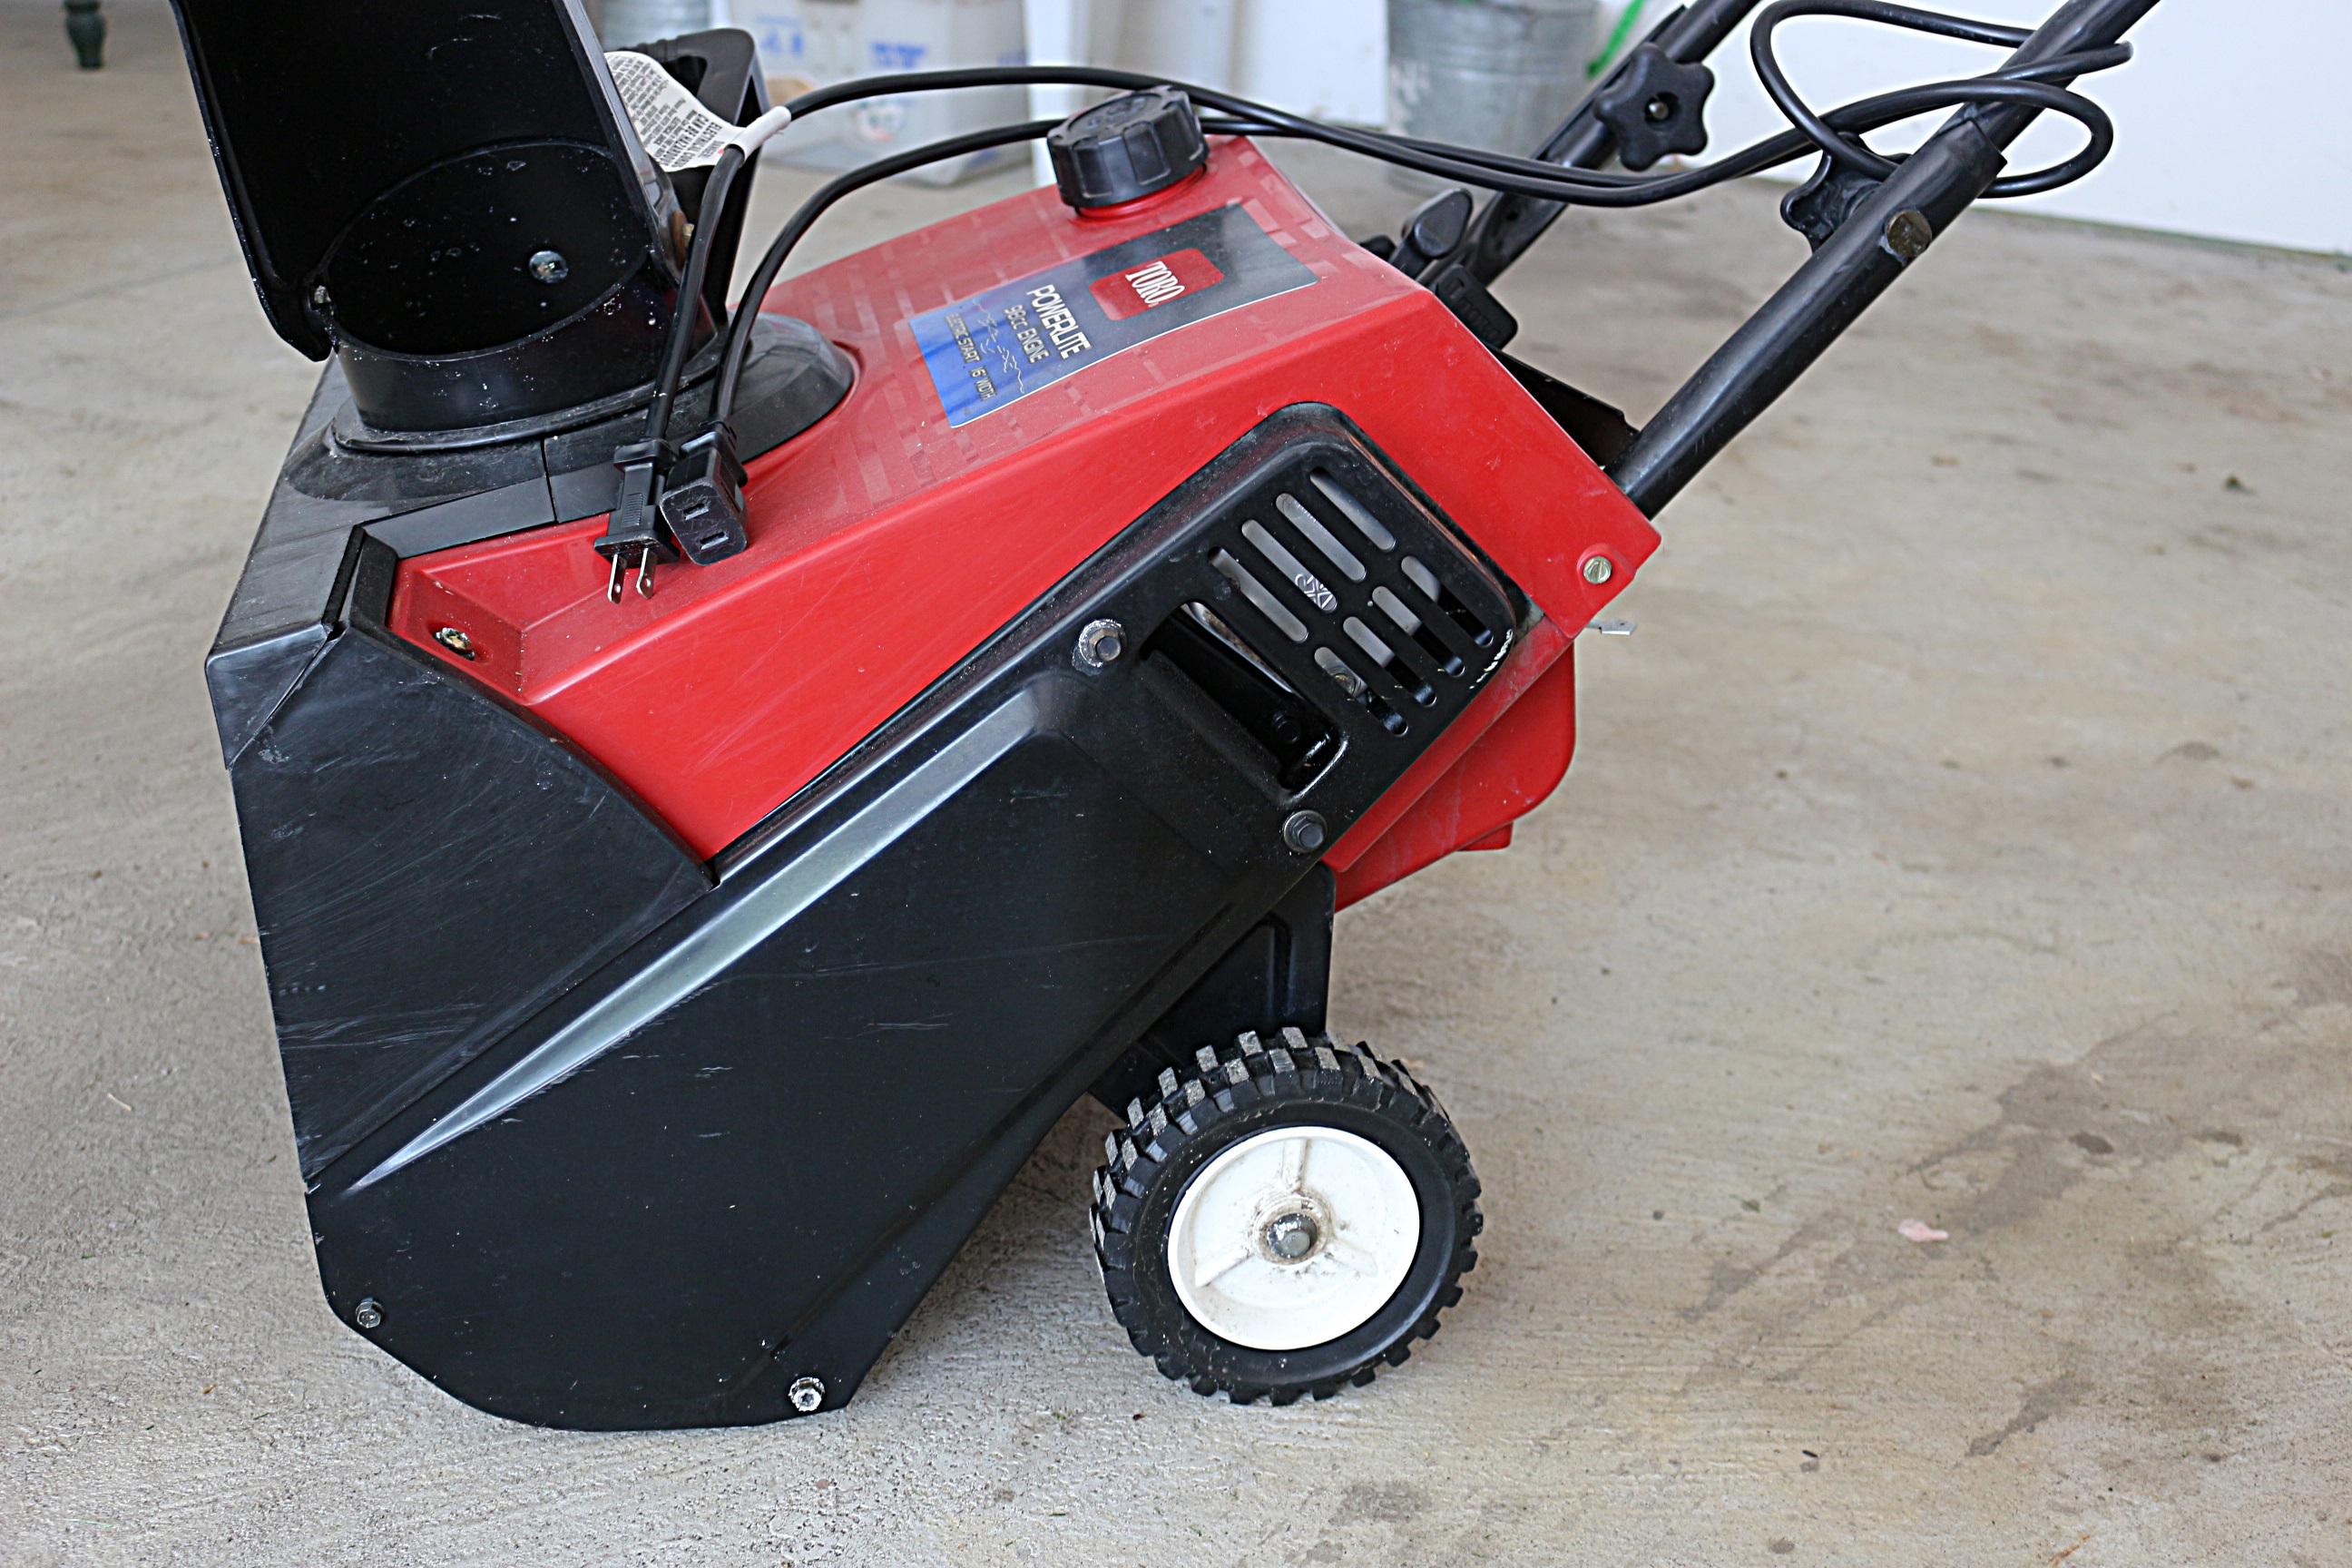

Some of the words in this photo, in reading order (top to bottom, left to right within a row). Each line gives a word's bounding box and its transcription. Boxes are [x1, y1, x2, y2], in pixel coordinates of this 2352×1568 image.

[684, 126, 699, 137] BE
[687, 122, 721, 152] ELECTRICAL
[691, 113, 708, 129] CAN
[1124, 260, 1185, 302] TORO
[1025, 282, 1092, 359] POWERLITE
[944, 311, 968, 339] ELECTRIC
[956, 338, 980, 365] START
[975, 376, 996, 400] WIDTH
[1015, 327, 1049, 364] ENGINE
